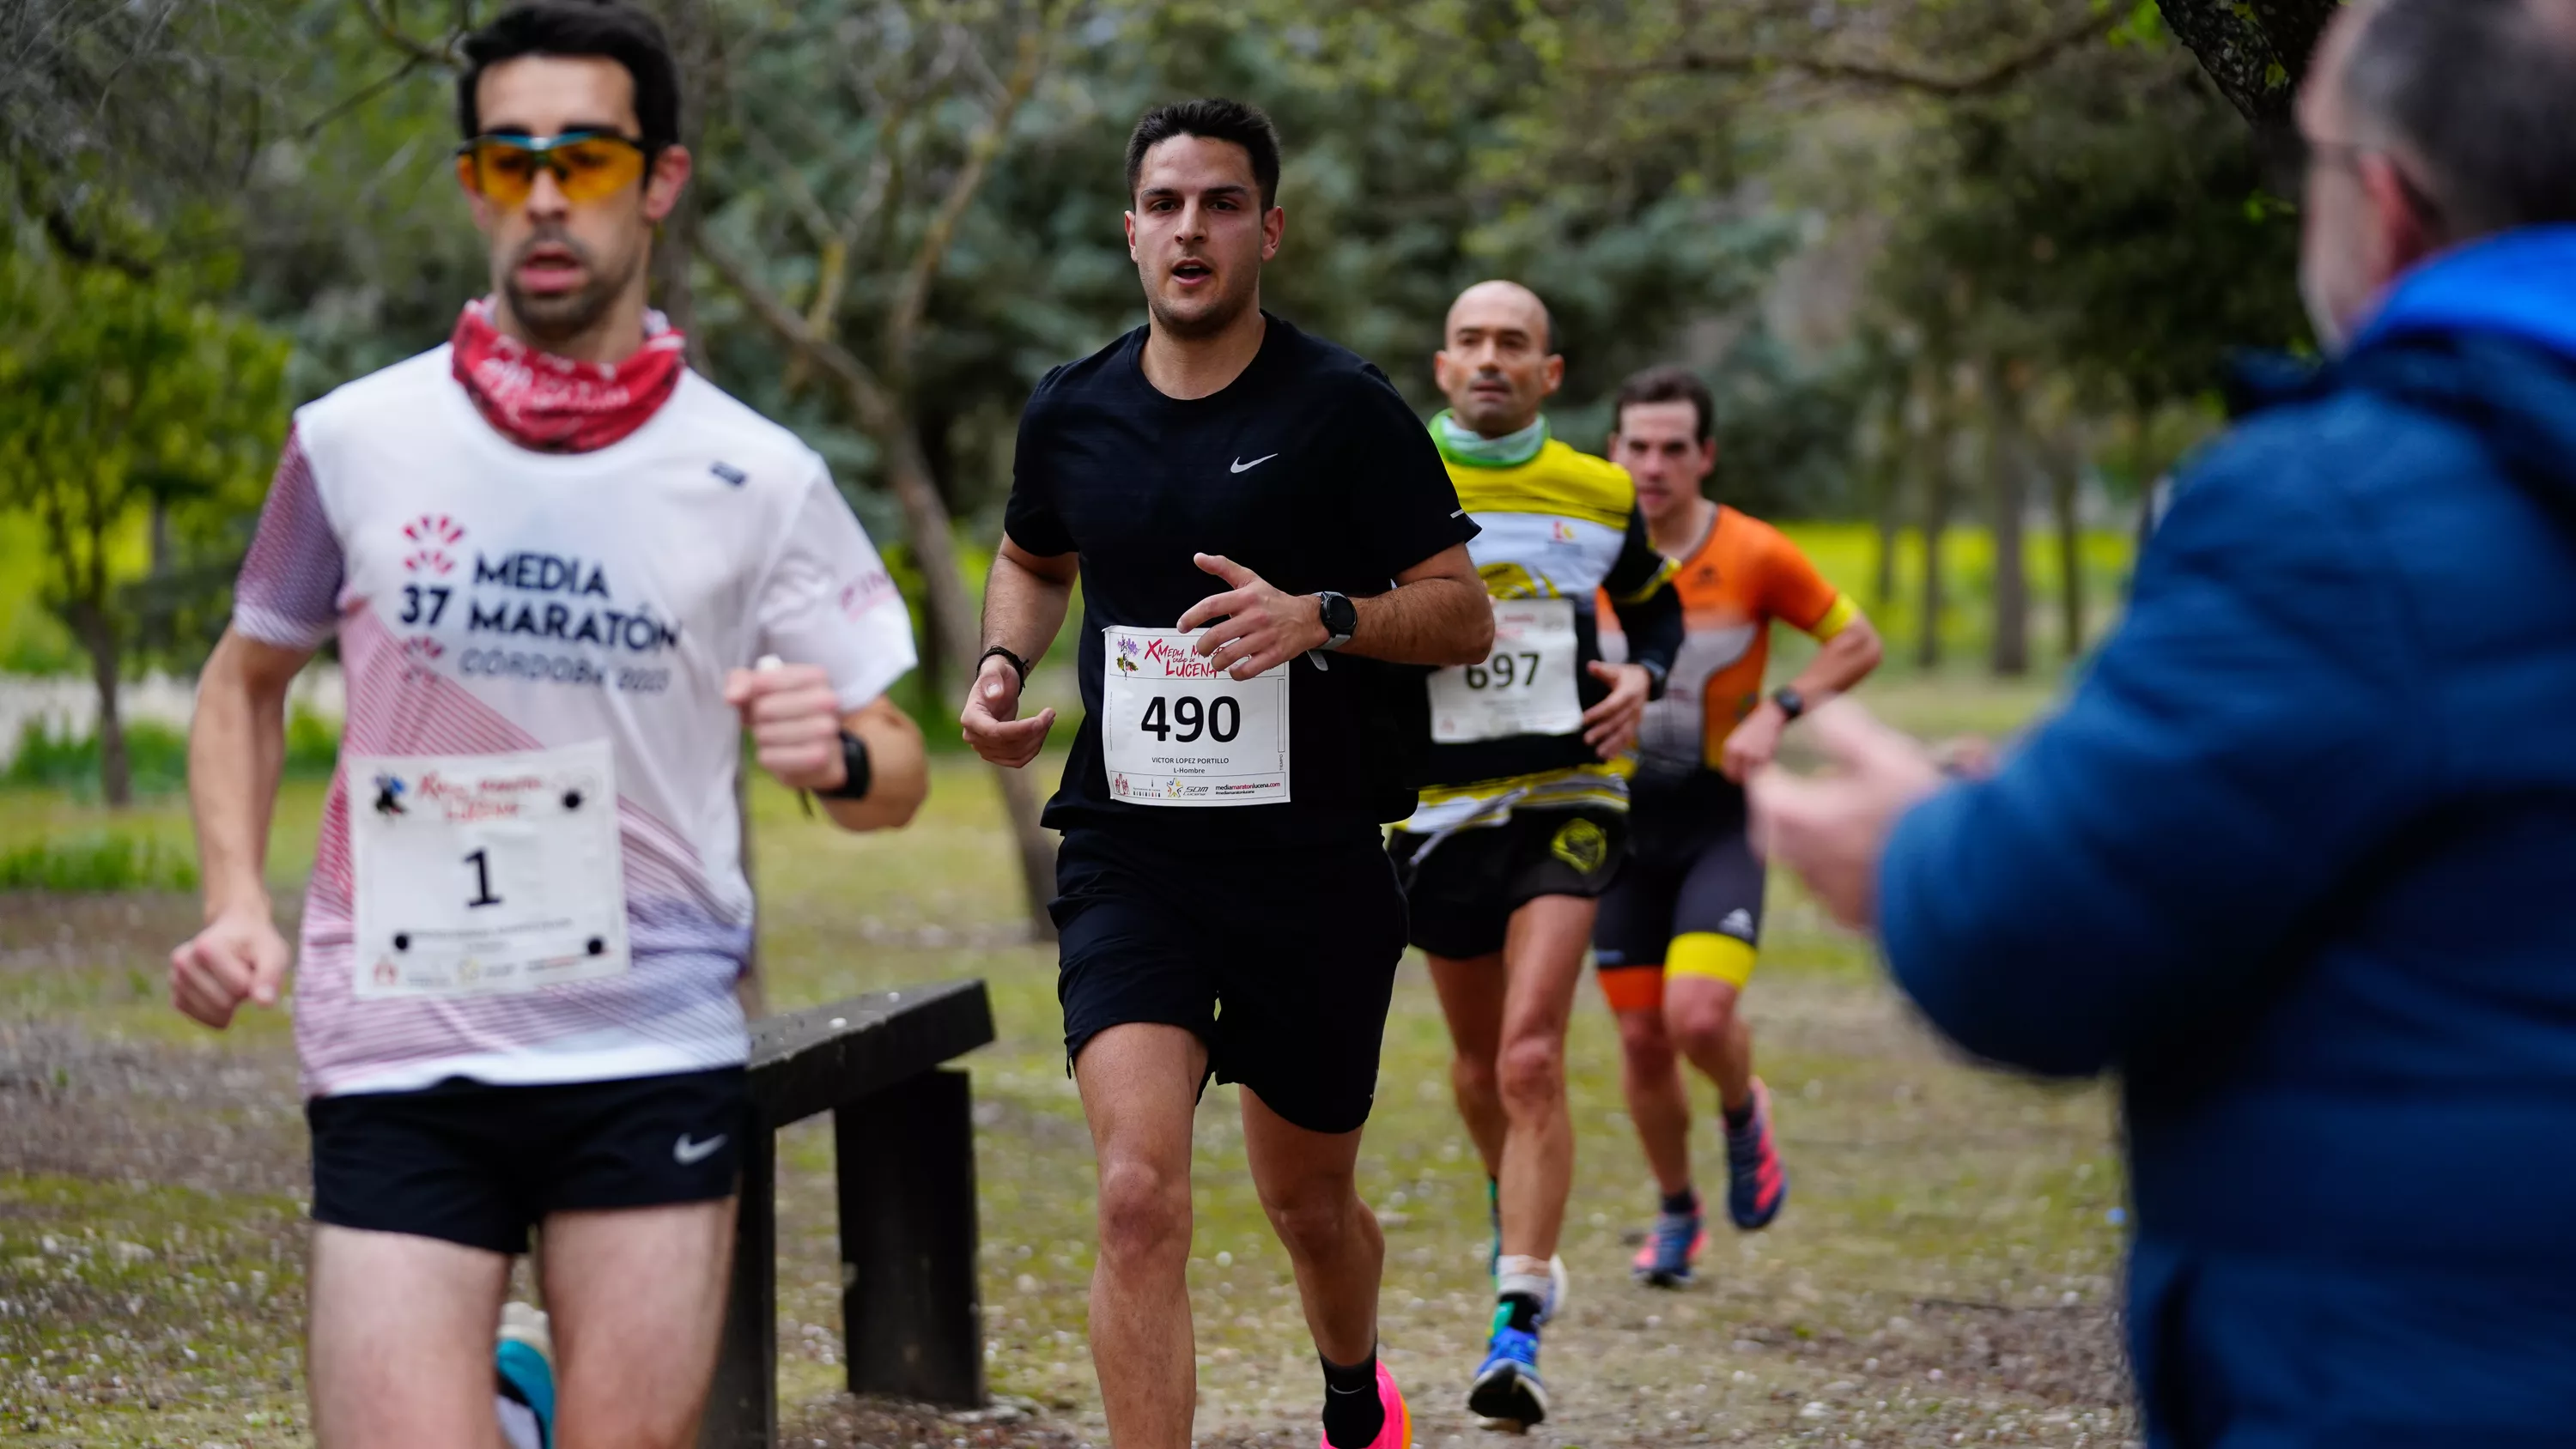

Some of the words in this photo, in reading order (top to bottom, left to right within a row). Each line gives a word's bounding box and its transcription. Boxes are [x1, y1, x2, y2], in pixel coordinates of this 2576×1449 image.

[474, 552, 610, 598] MEDIA
[401, 584, 452, 626] 37
[469, 599, 681, 652] MARATÓN
[1144, 638, 1163, 664] X
[1465, 653, 1540, 689] 697
[1141, 696, 1241, 743] 490
[1215, 782, 1281, 791] mediamaratonlucena.com
[463, 846, 504, 908] 1
